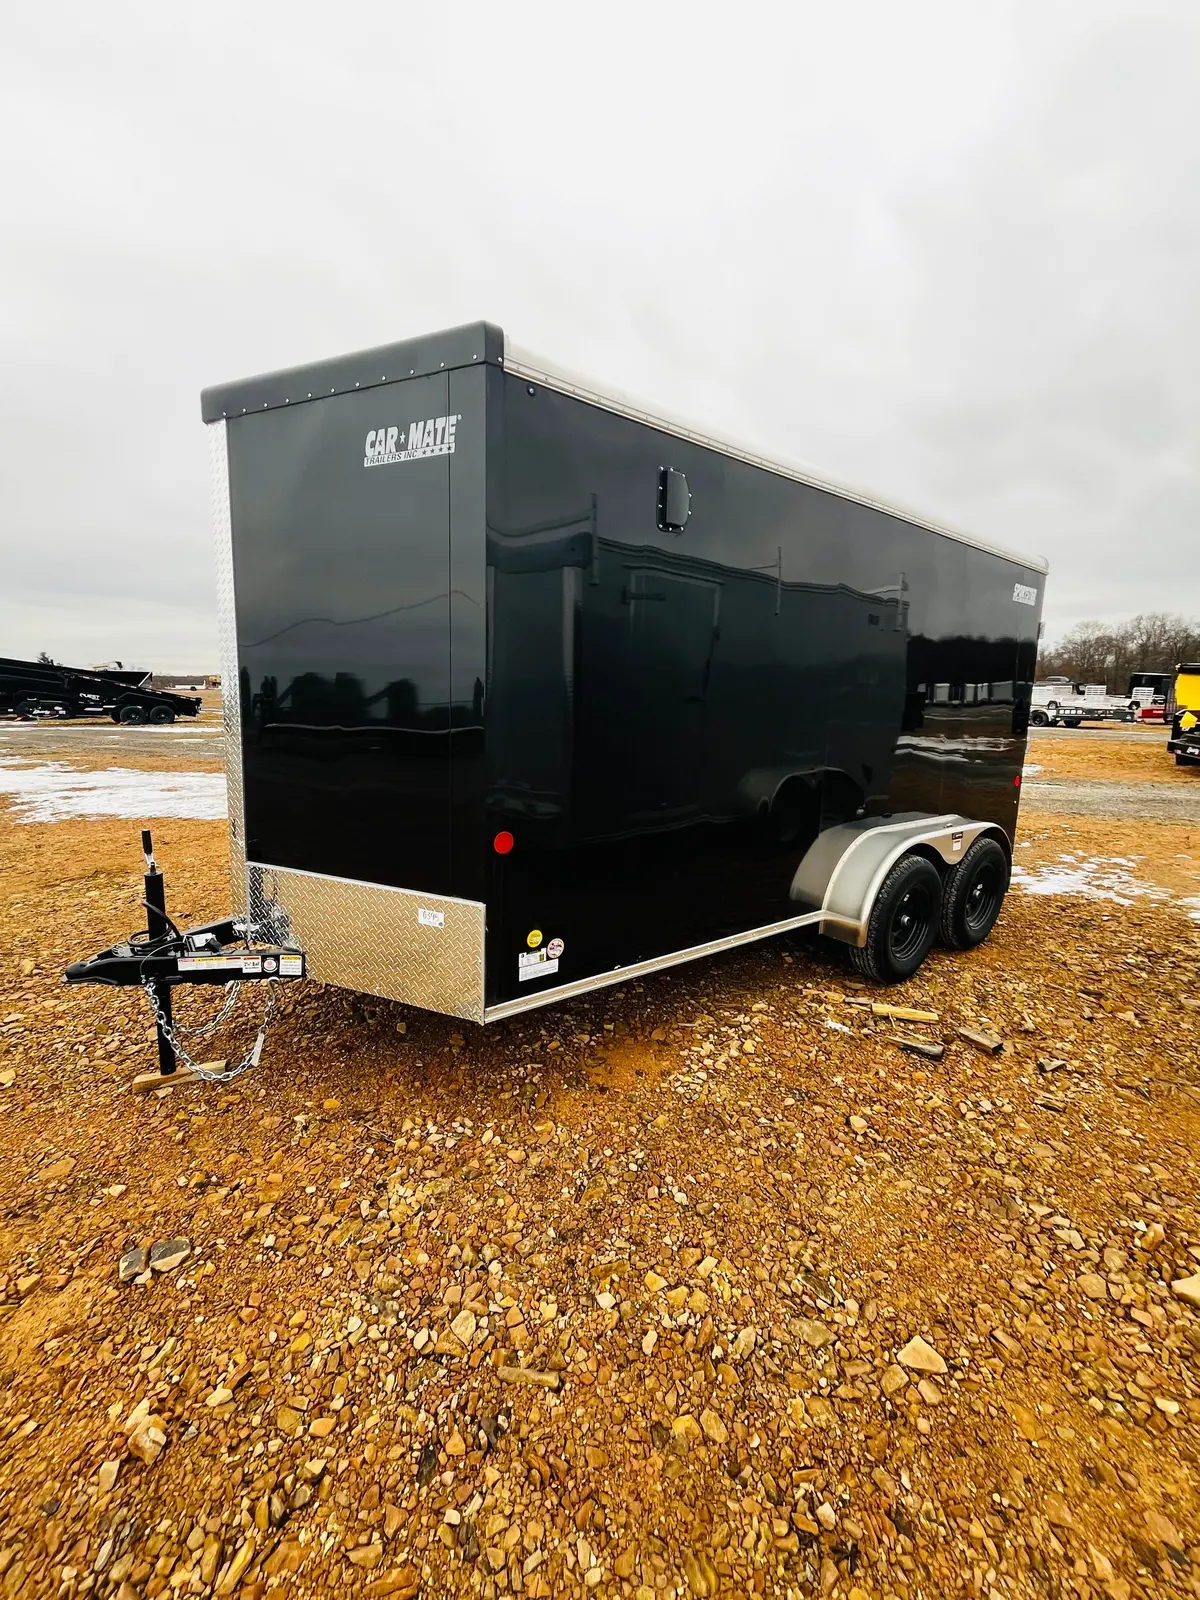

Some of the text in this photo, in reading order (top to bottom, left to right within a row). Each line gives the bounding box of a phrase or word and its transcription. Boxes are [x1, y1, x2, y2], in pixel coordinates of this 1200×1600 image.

[365, 415, 457, 457] CAR MATE
[365, 452, 402, 466] TRAILERS
